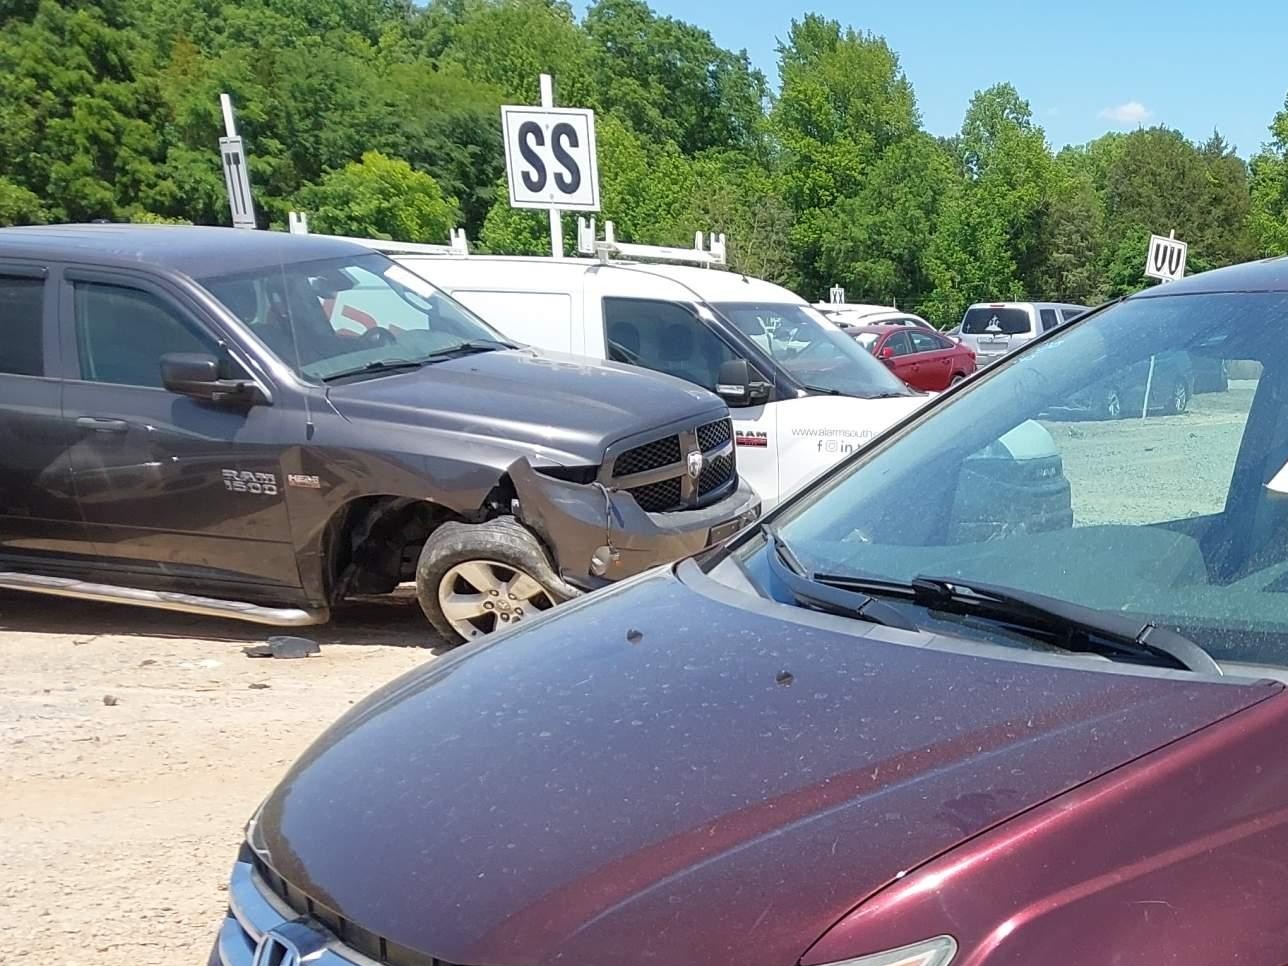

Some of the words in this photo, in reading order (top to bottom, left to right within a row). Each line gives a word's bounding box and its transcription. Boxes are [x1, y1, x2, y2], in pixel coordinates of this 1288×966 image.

[518, 121, 581, 195] SS
[224, 152, 247, 215] TT
[736, 430, 768, 438] RAM
[792, 427, 875, 438] www.alarmsouth
[222, 469, 277, 484] RAM
[224, 480, 278, 495] 1500
